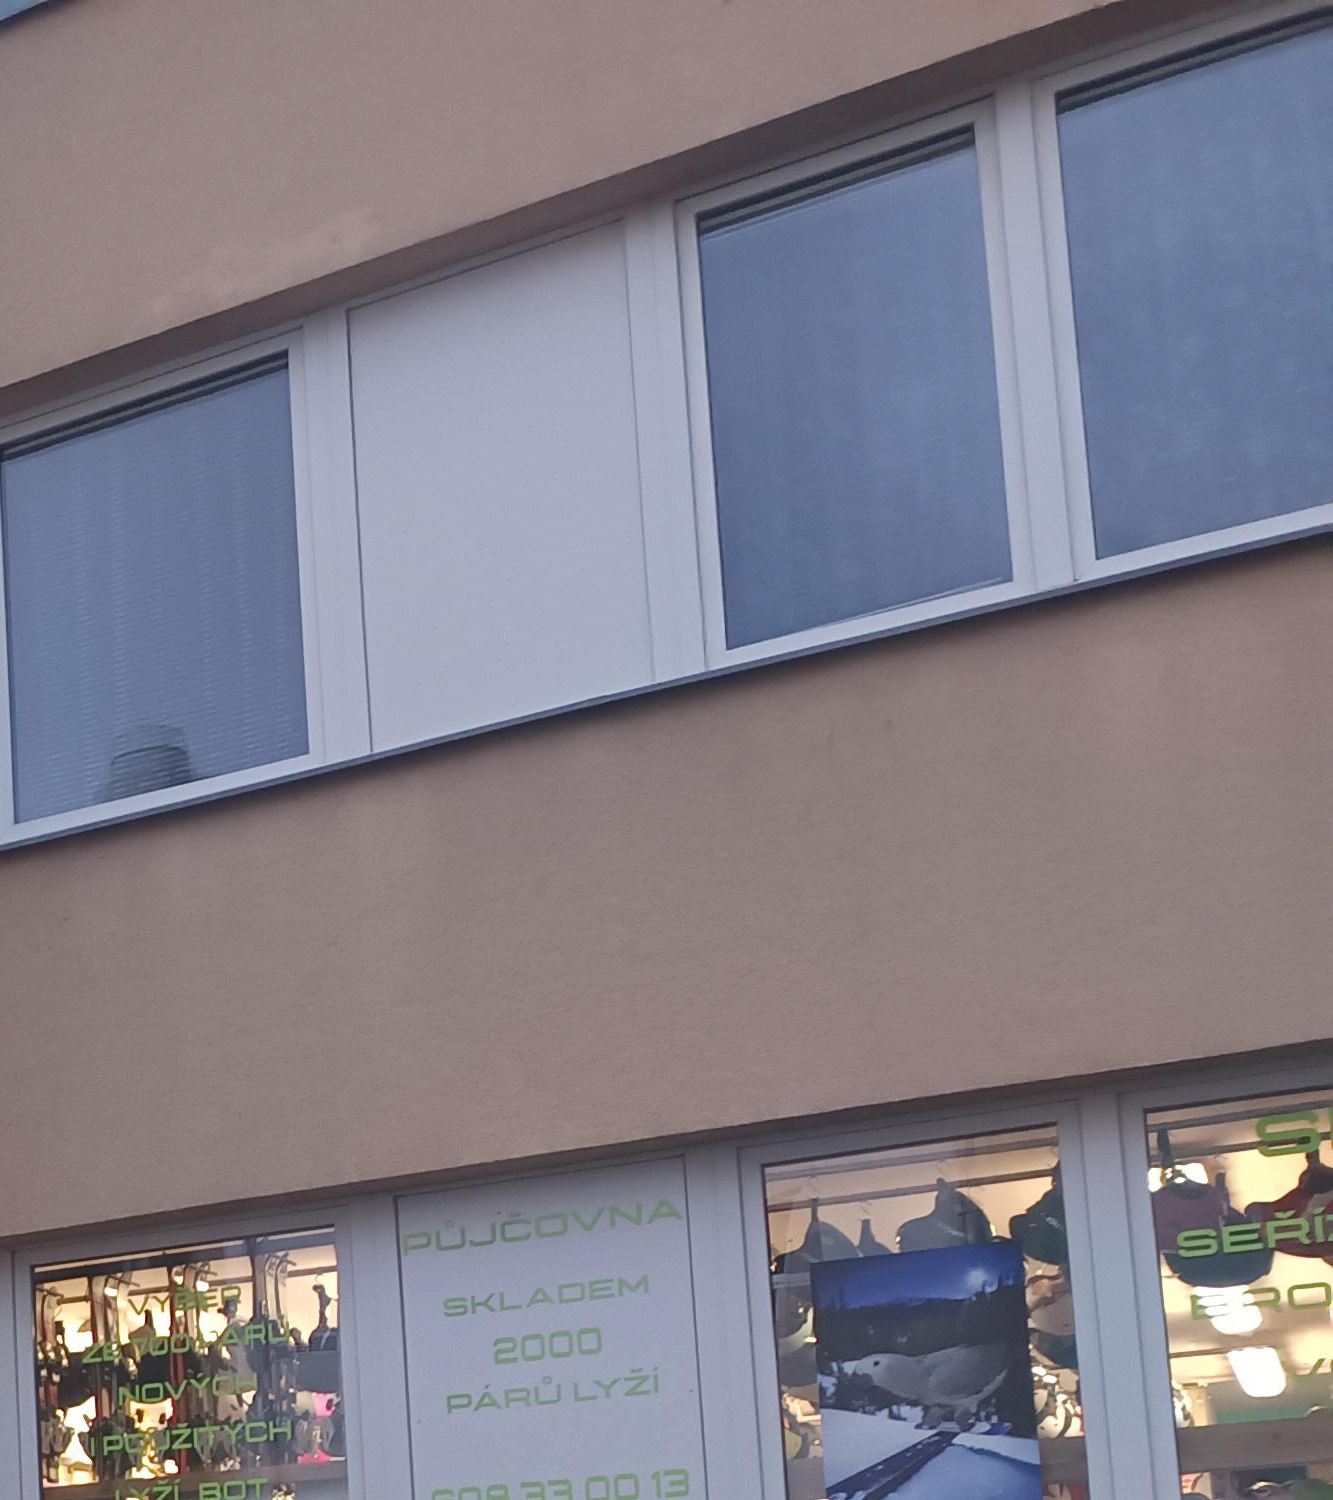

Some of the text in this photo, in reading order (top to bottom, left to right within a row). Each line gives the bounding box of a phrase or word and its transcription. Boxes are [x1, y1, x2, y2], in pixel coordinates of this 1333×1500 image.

[401, 1198, 683, 1255] PŮJČOVNA
[442, 1274, 651, 1317] SKLADEM
[493, 1327, 602, 1365] 2000
[445, 1366, 660, 1414] PÁRŮ LYŽÍ
[651, 1468, 690, 1499] 13
